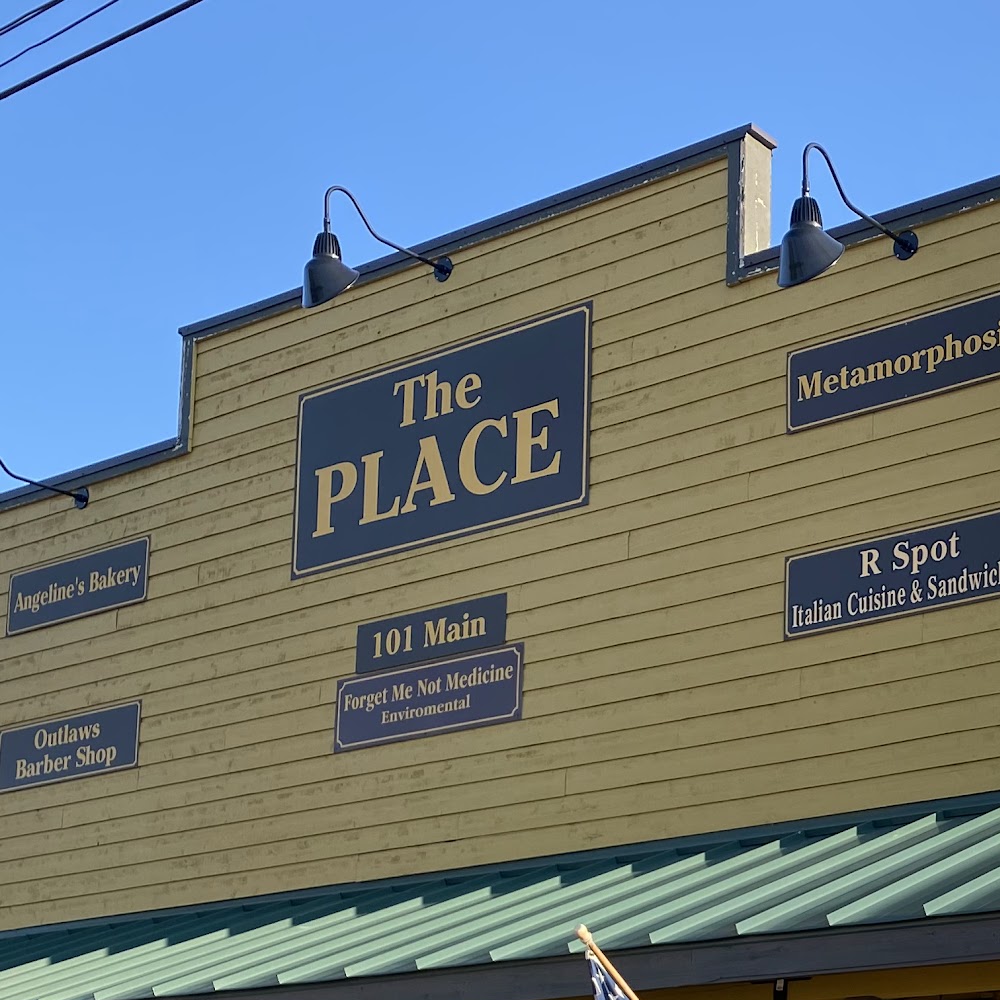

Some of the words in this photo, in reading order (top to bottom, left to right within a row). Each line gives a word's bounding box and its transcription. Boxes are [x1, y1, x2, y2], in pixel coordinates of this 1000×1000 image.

[394, 369, 482, 428] The
[312, 398, 562, 538] PLACE
[859, 549, 882, 578] R
[892, 531, 960, 575] Spot
[14, 577, 85, 613] Angeline's
[89, 563, 141, 592] Bakery
[791, 600, 843, 628] Italian
[847, 584, 907, 616] Cuisine
[909, 579, 924, 604] &
[373, 625, 413, 659] 101
[423, 612, 487, 648] Main
[344, 689, 388, 712] Forget
[391, 684, 413, 702] Me
[417, 676, 442, 697] Not
[446, 664, 514, 692] Medicine
[381, 694, 471, 724] Enviromental
[34, 720, 101, 749] Outlaws
[15, 752, 72, 779] Barber
[76, 743, 117, 768] Shop
